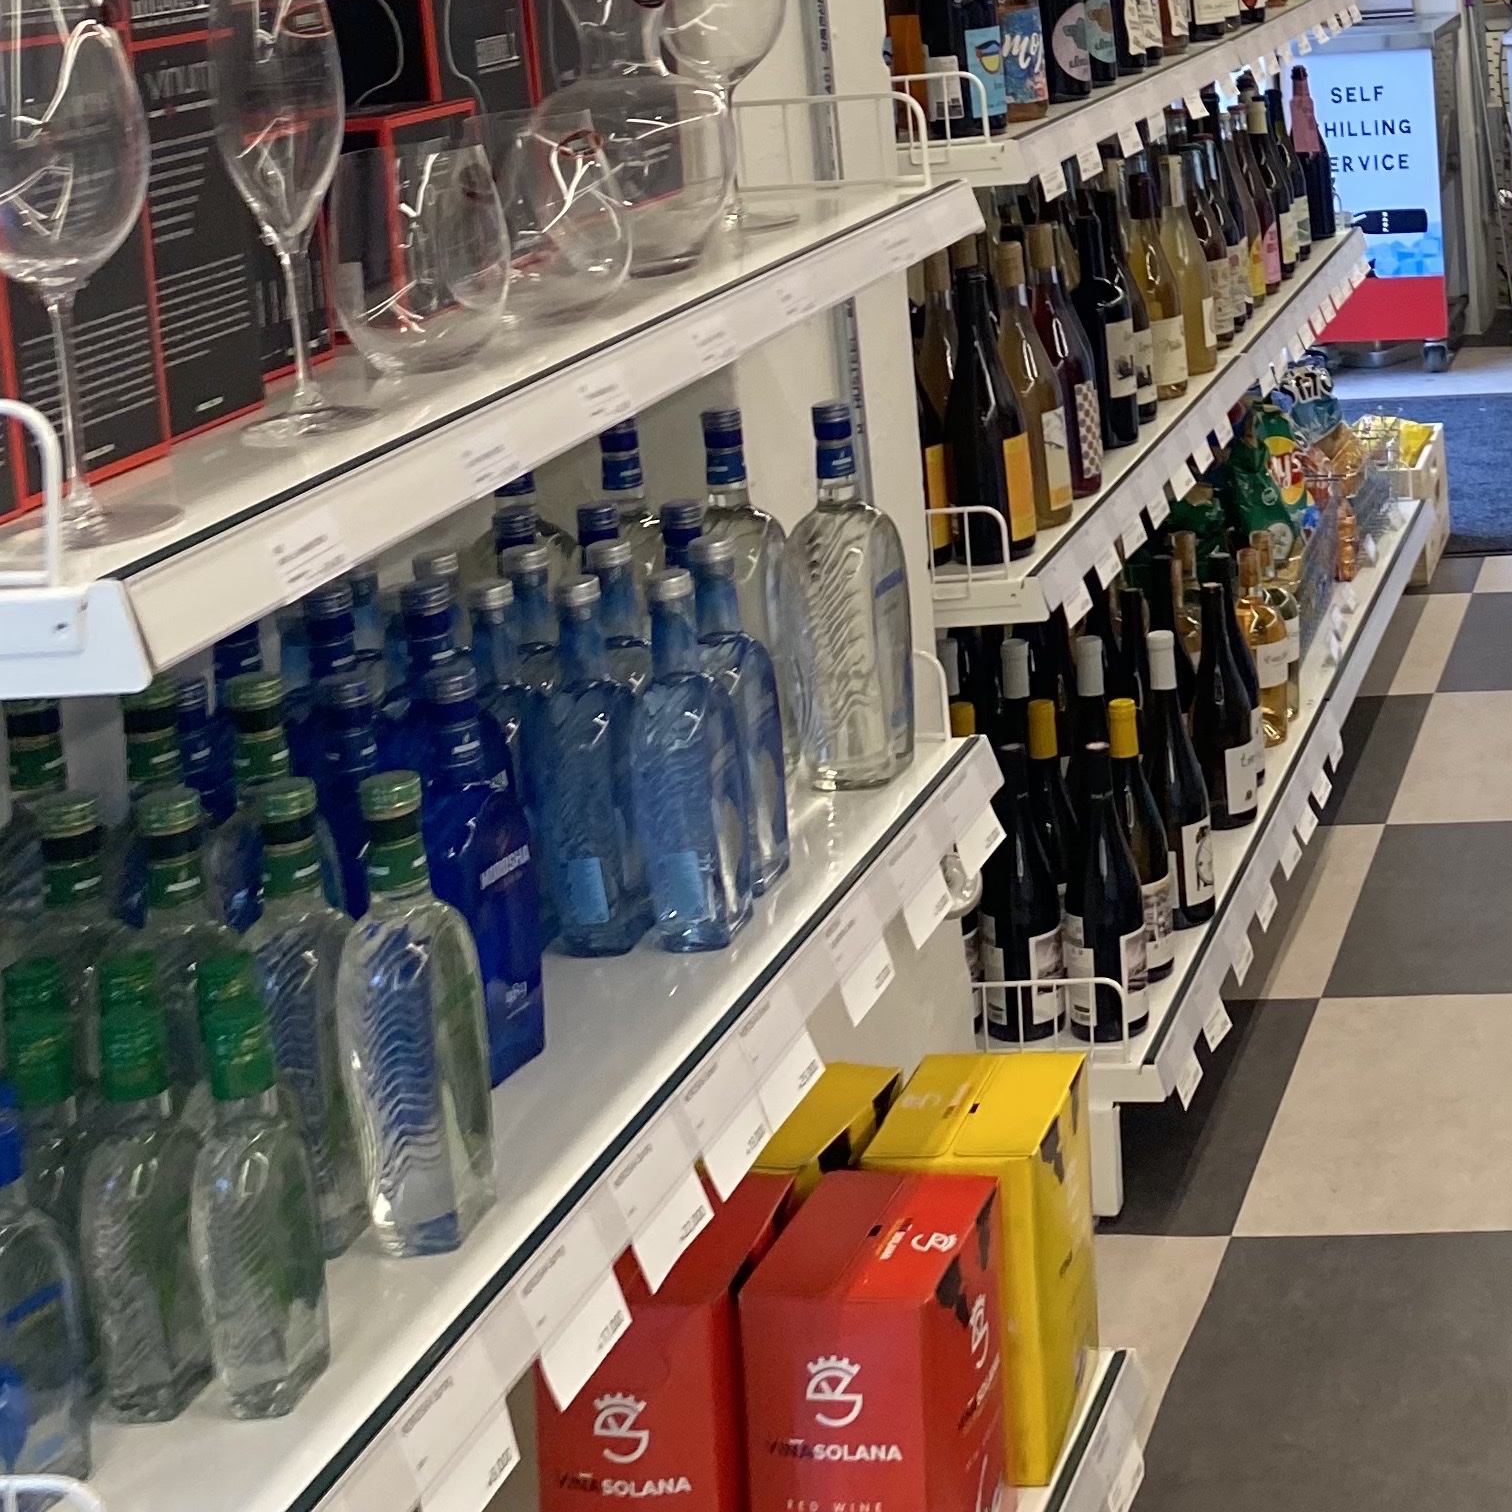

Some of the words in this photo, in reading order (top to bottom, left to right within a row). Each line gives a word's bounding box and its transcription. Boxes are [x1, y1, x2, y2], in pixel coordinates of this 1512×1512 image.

[1331, 86, 1384, 103] SELF
[1324, 119, 1411, 138] HILLING
[1330, 154, 1410, 173] ERVICE
[813, 1443, 903, 1462] SOLANA
[601, 1476, 692, 1498] SOLANA
